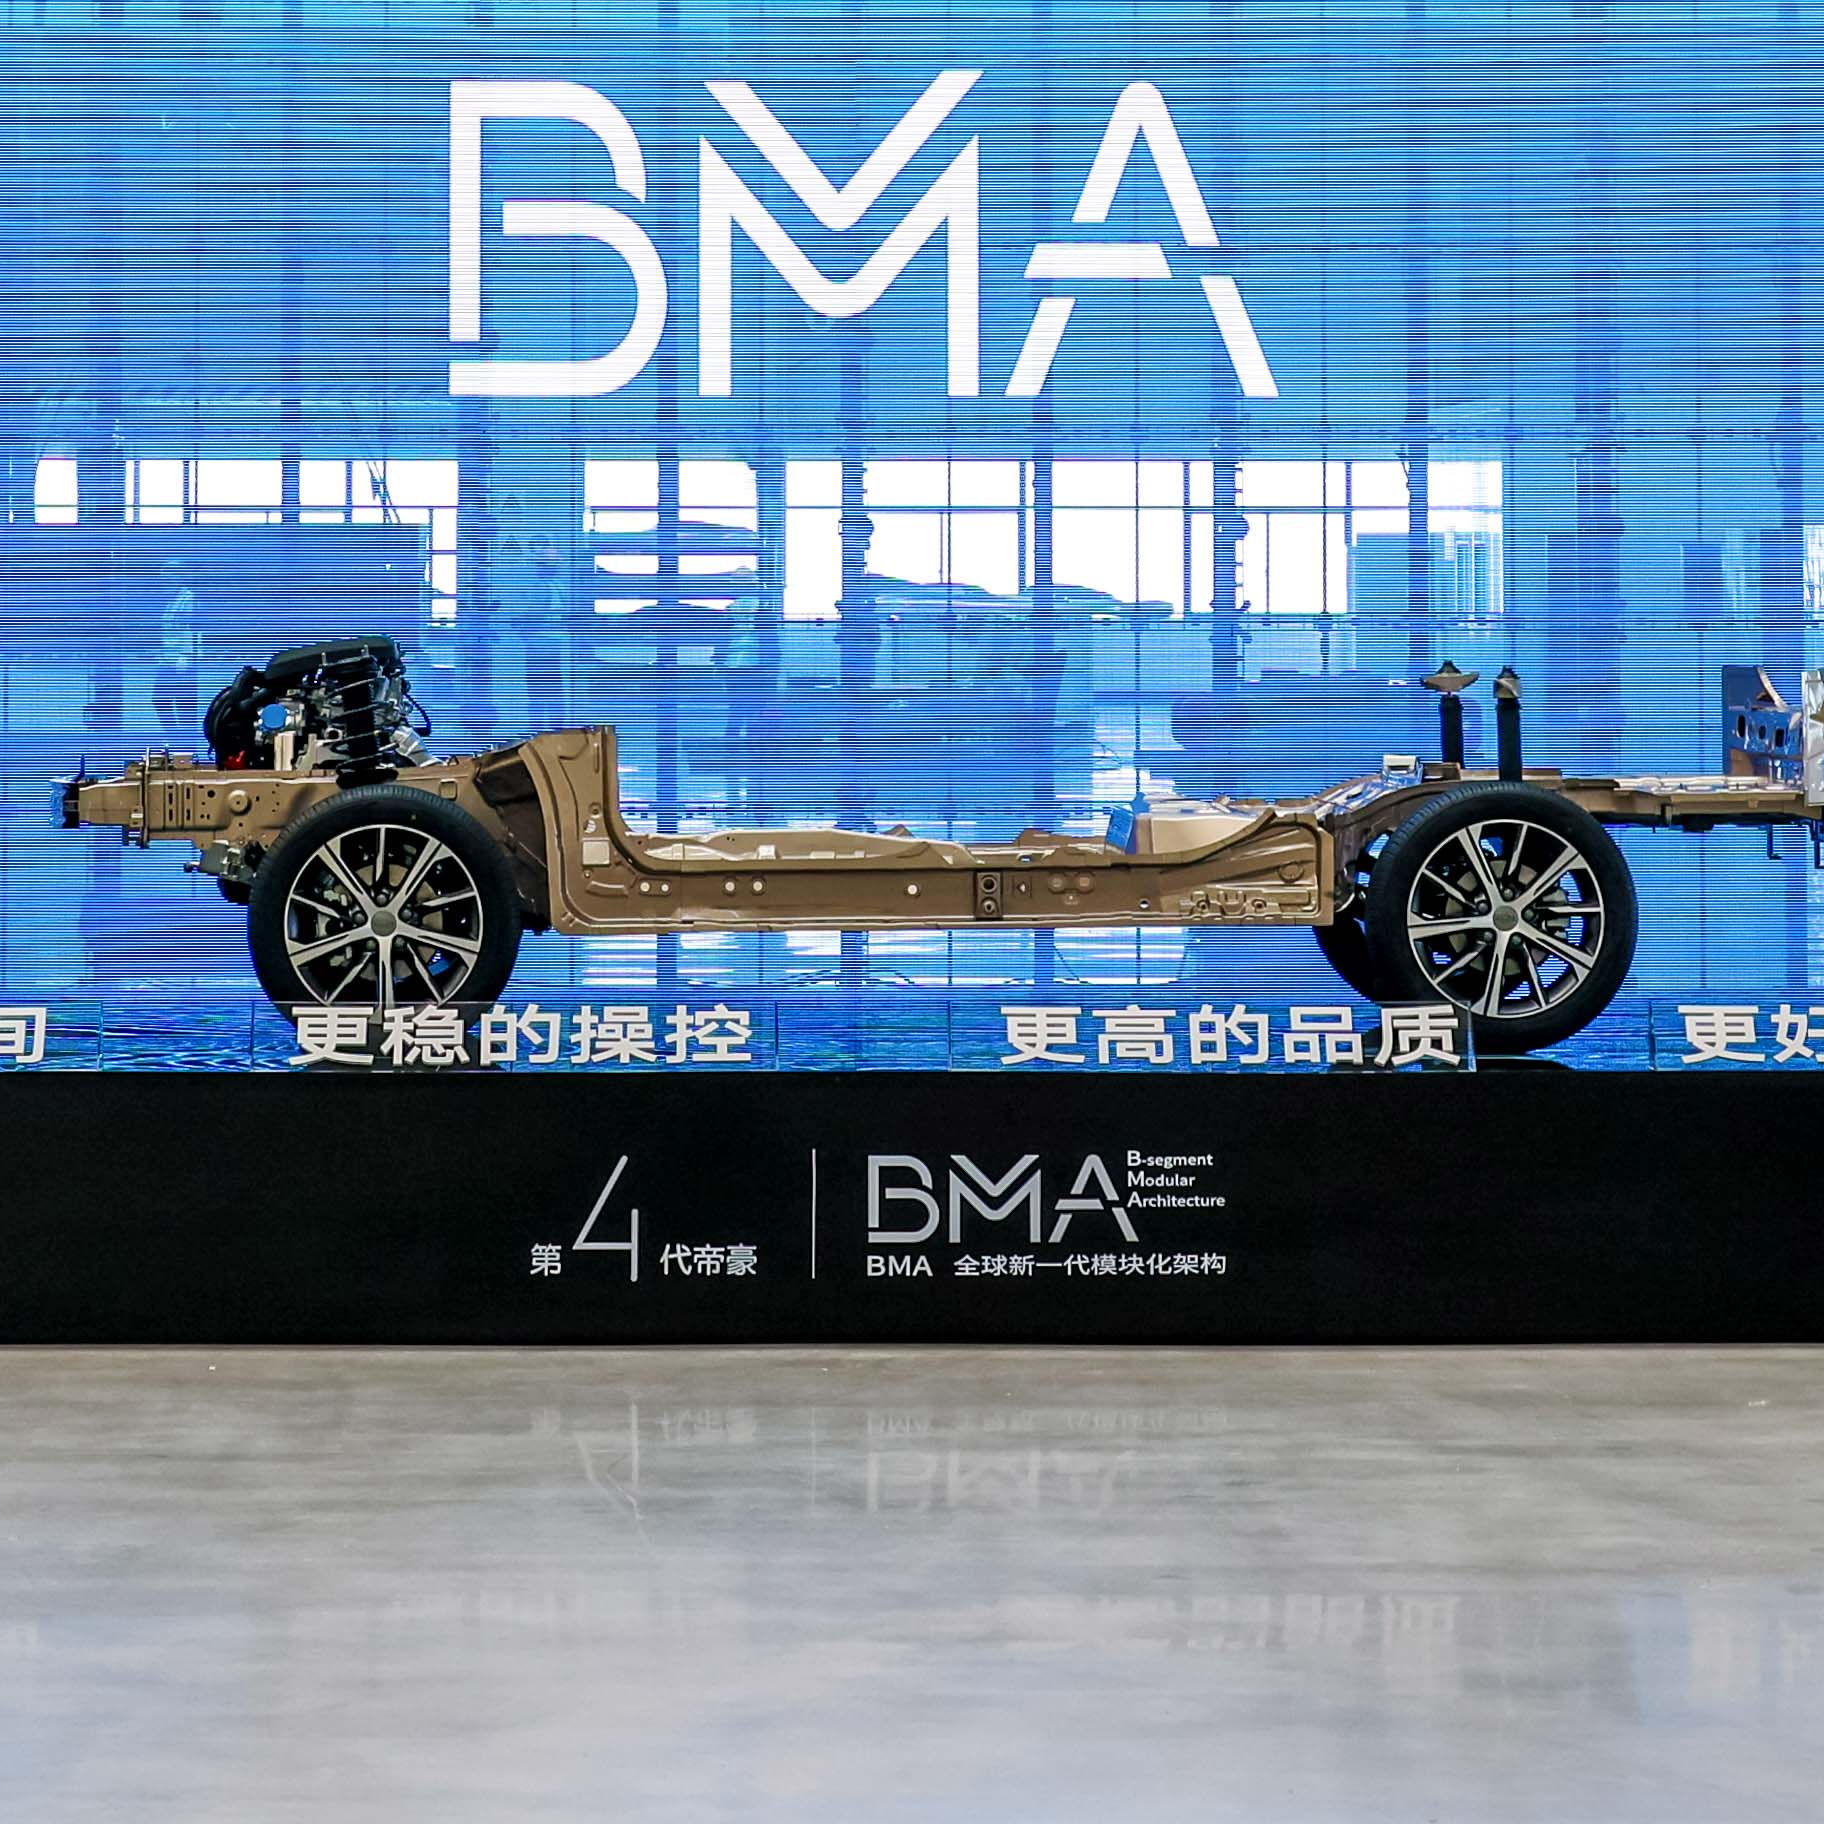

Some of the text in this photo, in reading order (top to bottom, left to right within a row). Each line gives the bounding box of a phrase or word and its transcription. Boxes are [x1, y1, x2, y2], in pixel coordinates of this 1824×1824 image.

[448, 69, 1280, 397] BMA
[286, 1002, 756, 1067] 更稳的操控
[998, 1003, 1463, 1067] 更高的品质
[1126, 1149, 1214, 1169] B-segment
[1127, 1170, 1196, 1187] Modular
[866, 1154, 1139, 1243] BMA
[1126, 1191, 1226, 1208] Architecture
[866, 1253, 1227, 1276] BMA 全球新一代模块化架构
